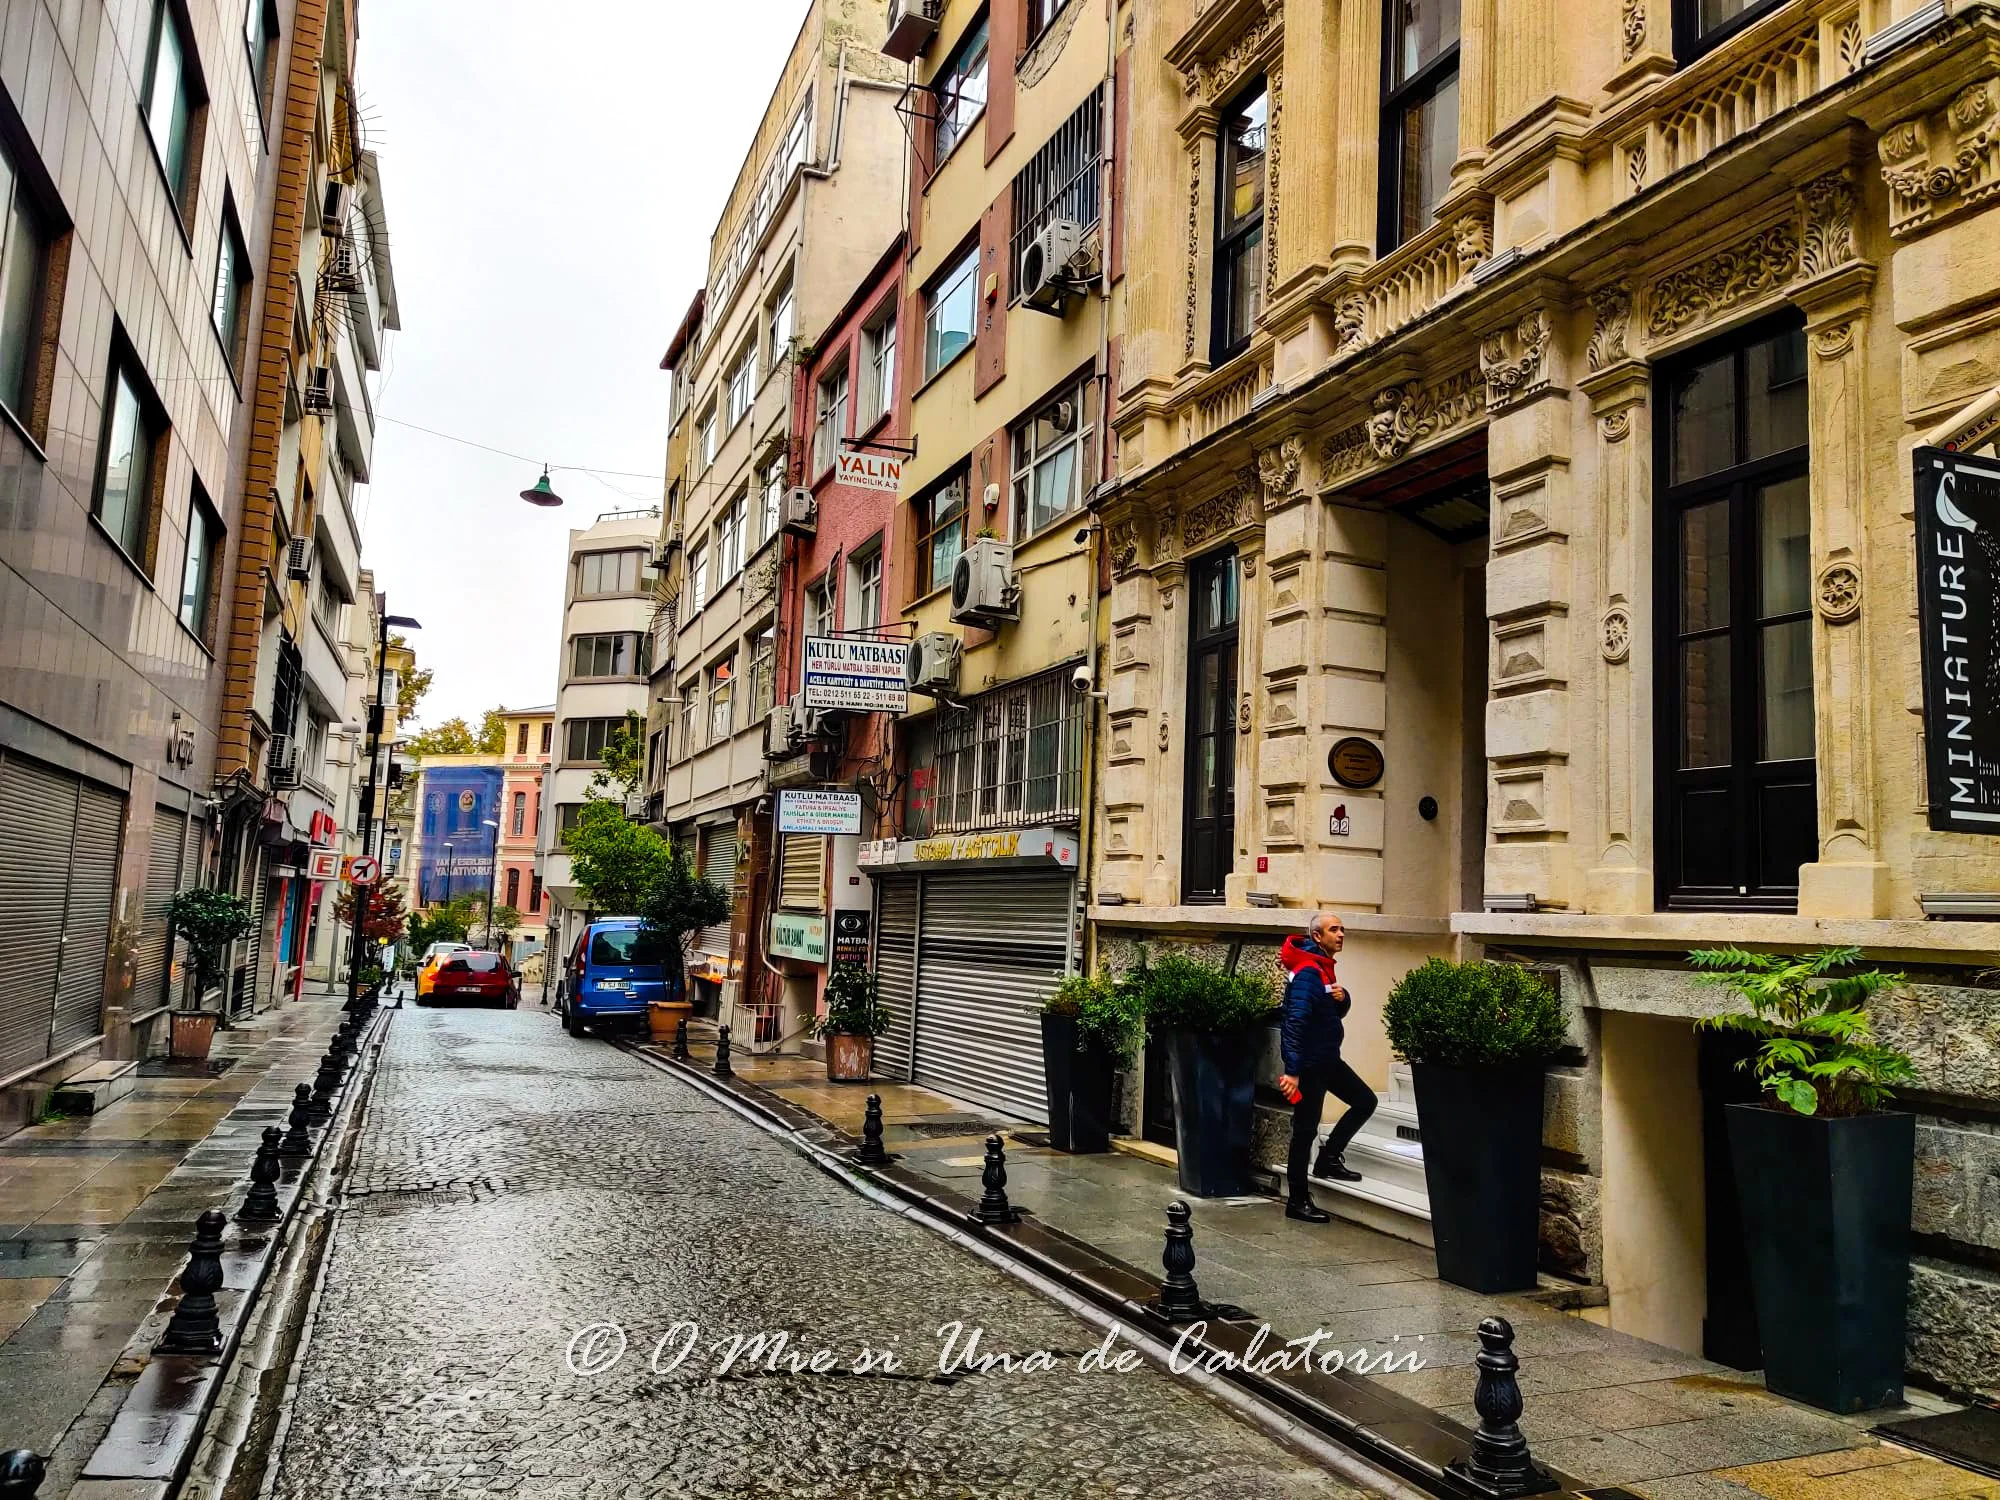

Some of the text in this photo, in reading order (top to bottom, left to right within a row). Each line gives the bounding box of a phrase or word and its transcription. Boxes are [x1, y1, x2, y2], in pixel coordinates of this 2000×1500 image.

[839, 455, 900, 480] YALIN
[839, 474, 883, 487] YAYINCILIK
[808, 642, 905, 664] KUTLU MATBAASI
[812, 661, 822, 670] HER
[843, 662, 863, 673] MATBAA
[882, 665, 901, 675] YAPILIR
[1936, 532, 1975, 804] MINIATURE
[810, 676, 826, 685] ACELE
[808, 688, 822, 697] TEL:
[824, 689, 839, 697] 0212
[841, 690, 851, 698] 511
[876, 693, 886, 701] 511
[785, 792, 858, 801] KUTLU MATBAASI
[1332, 820, 1348, 833] 22
[317, 856, 334, 874] E
